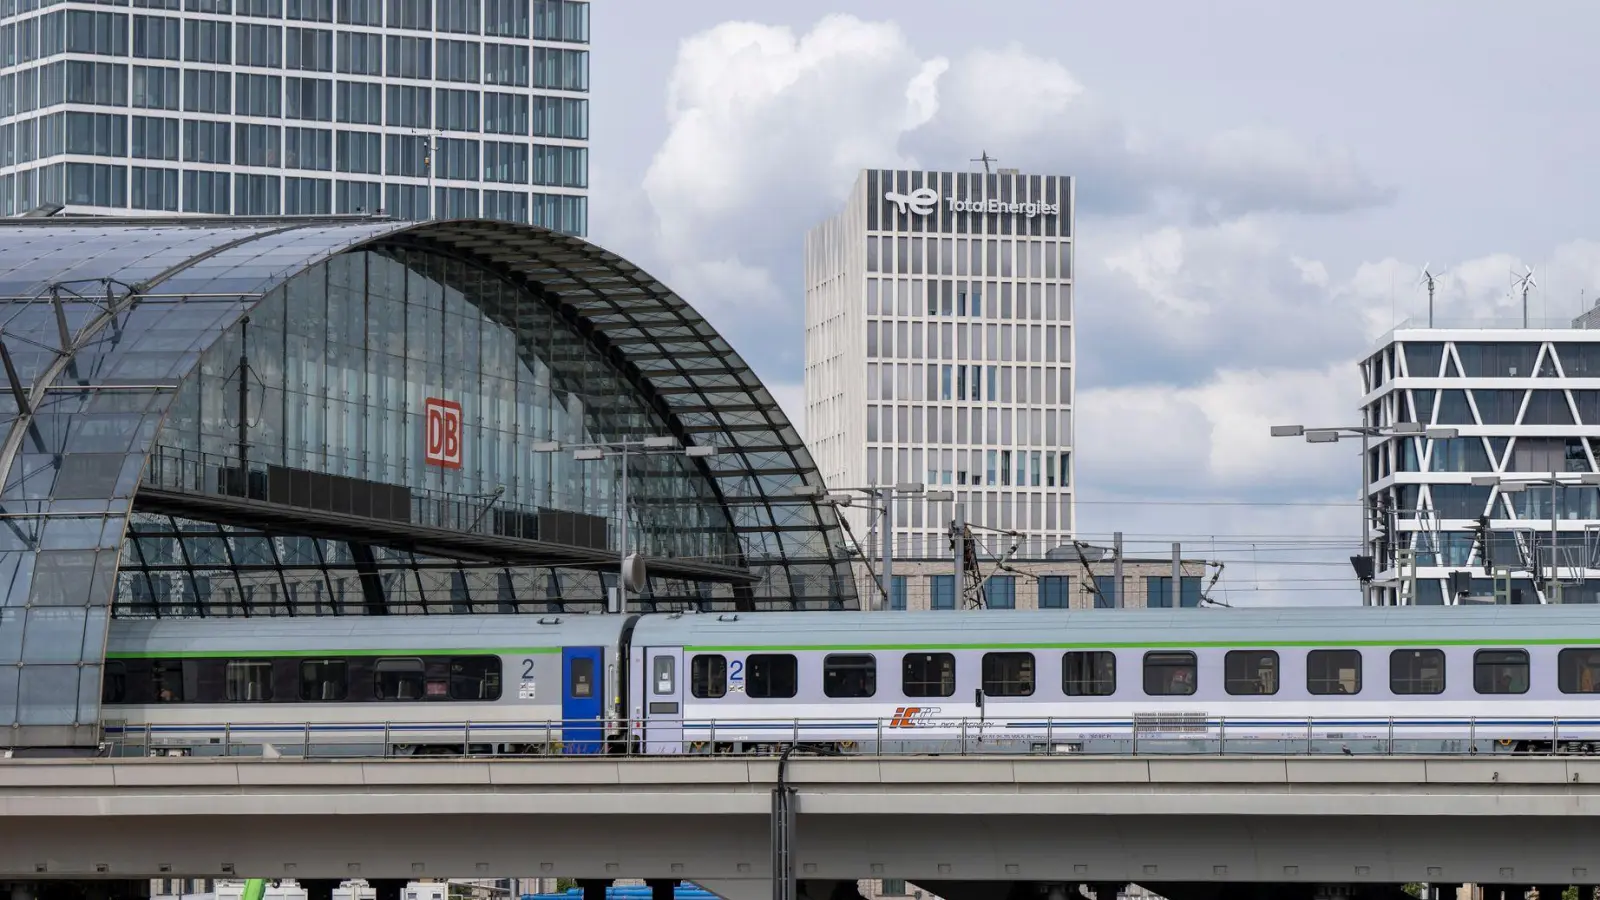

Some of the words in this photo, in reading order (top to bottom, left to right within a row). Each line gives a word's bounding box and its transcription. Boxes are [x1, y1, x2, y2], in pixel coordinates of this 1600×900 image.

[946, 197, 1060, 218] TotalEnergies
[429, 408, 458, 458] DB
[522, 658, 534, 679] 2
[729, 660, 743, 681] 2
